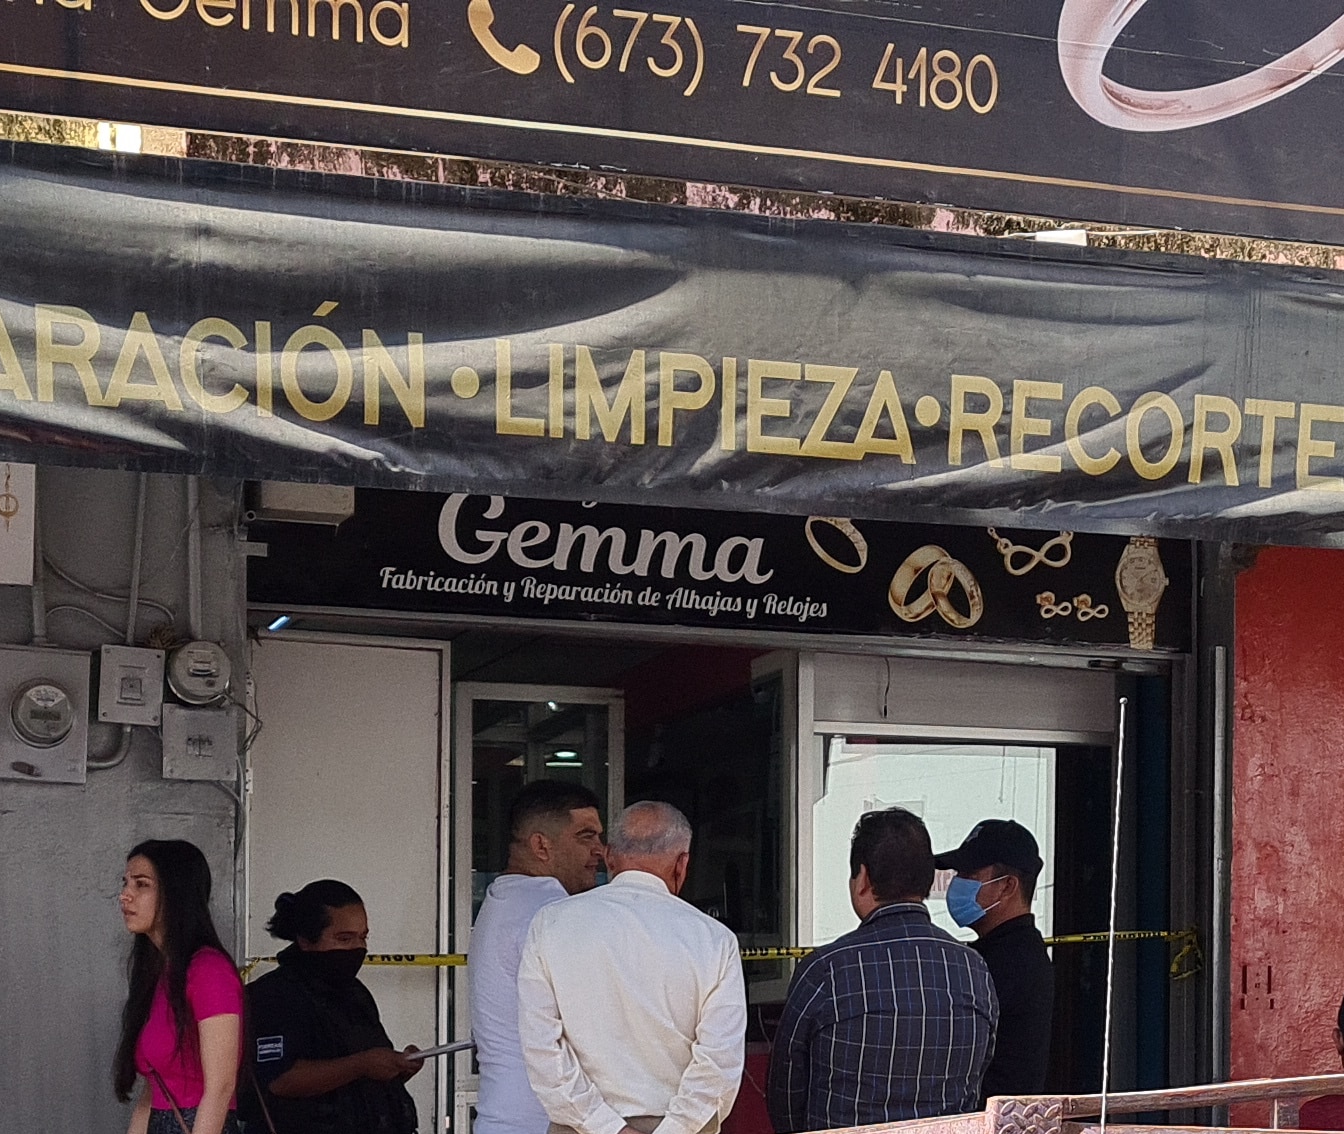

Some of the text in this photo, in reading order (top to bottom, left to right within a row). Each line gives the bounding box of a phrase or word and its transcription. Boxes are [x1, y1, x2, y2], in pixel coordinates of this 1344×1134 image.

[140, 0, 409, 48] emma
[555, 3, 999, 114] (673) 732 4180
[495, 338, 916, 466] LIMPIEZA
[437, 493, 774, 585] Gemma
[379, 566, 829, 623] Fabricación y Reparación de Alhajas y Relojes
